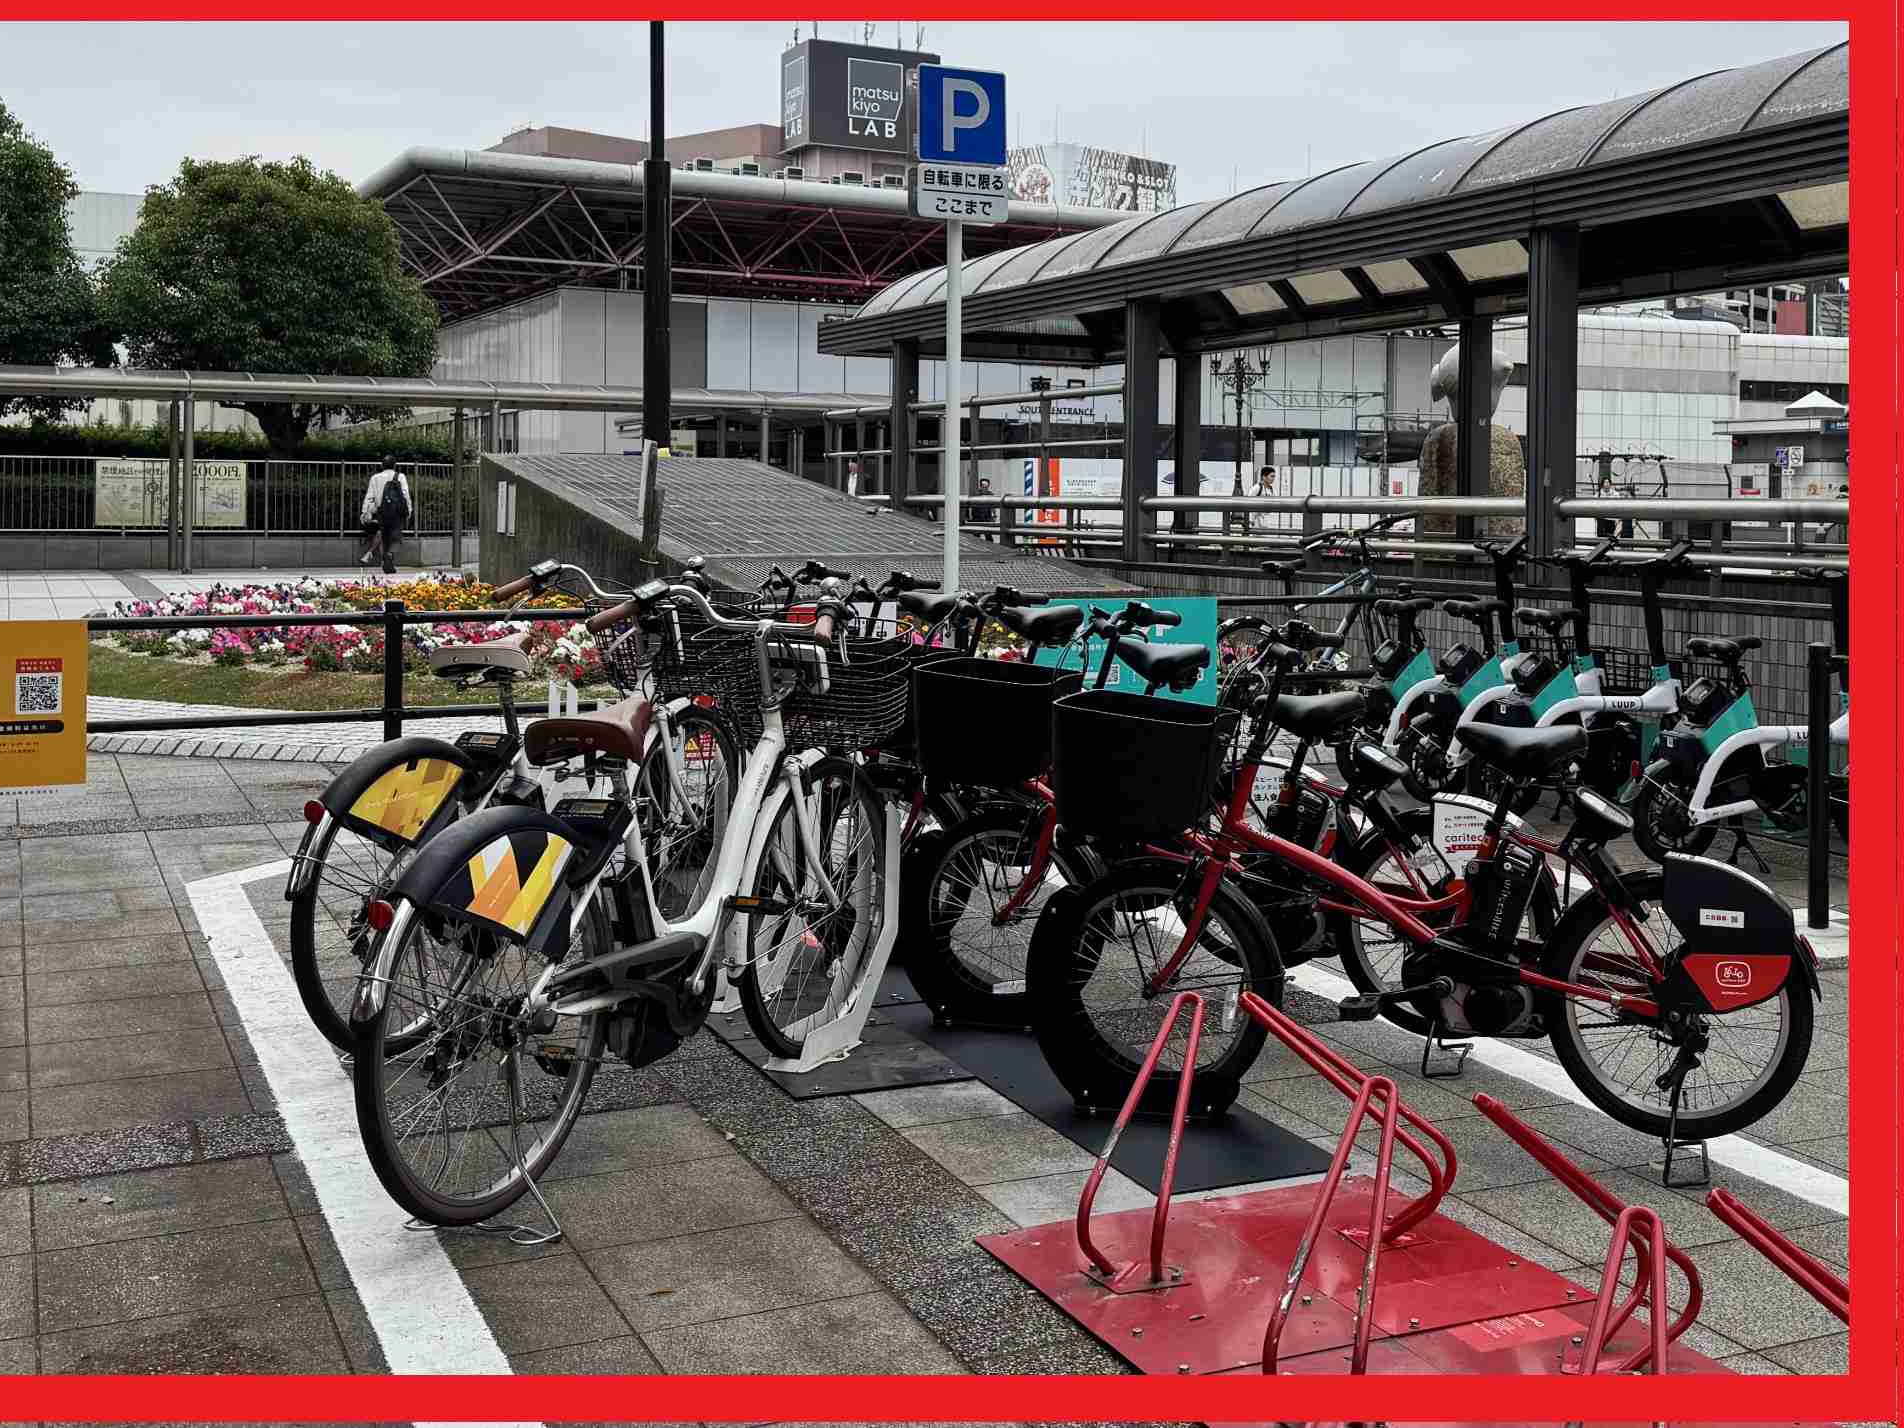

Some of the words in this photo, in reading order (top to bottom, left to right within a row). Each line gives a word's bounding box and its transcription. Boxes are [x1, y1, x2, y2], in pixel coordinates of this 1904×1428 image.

[852, 86, 899, 102] matsu
[852, 98, 881, 118] kiyo
[942, 77, 990, 152] P
[848, 118, 897, 139] LAB
[923, 168, 1004, 191] 自転車に限る
[935, 198, 993, 216] ここまで
[1611, 701, 1636, 710] LUUP
[1796, 732, 1809, 740] LU
